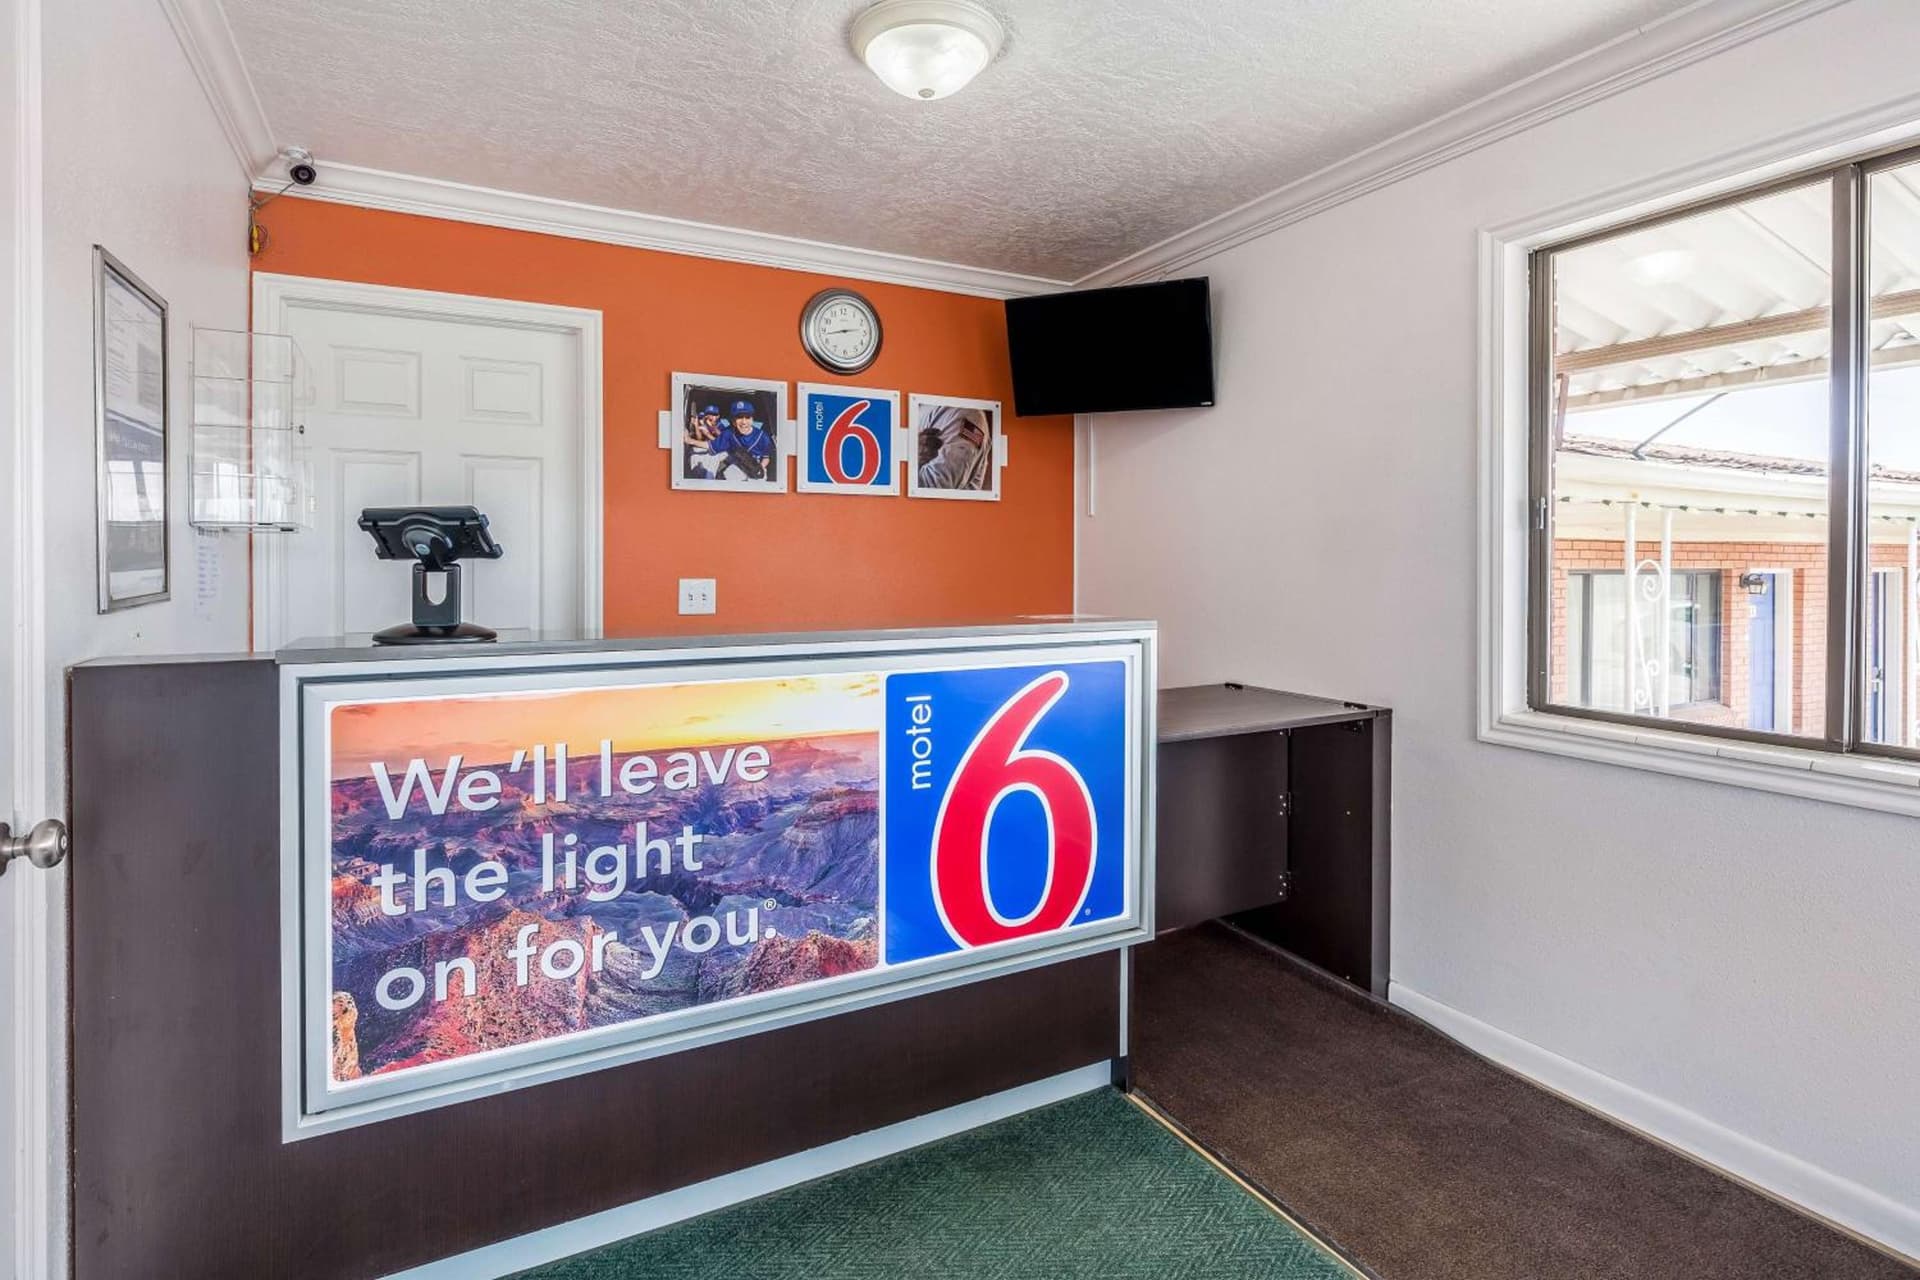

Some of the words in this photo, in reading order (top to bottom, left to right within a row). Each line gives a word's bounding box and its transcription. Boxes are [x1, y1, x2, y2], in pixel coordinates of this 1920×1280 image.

[840, 307, 847, 316] 12
[814, 401, 824, 431] motel
[822, 400, 882, 486] 6
[600, 739, 771, 798] leave
[905, 694, 932, 790] motel
[930, 670, 1098, 950] 6
[371, 848, 509, 917] the
[541, 821, 704, 902] light
[375, 956, 477, 1011] on
[507, 923, 618, 986] for
